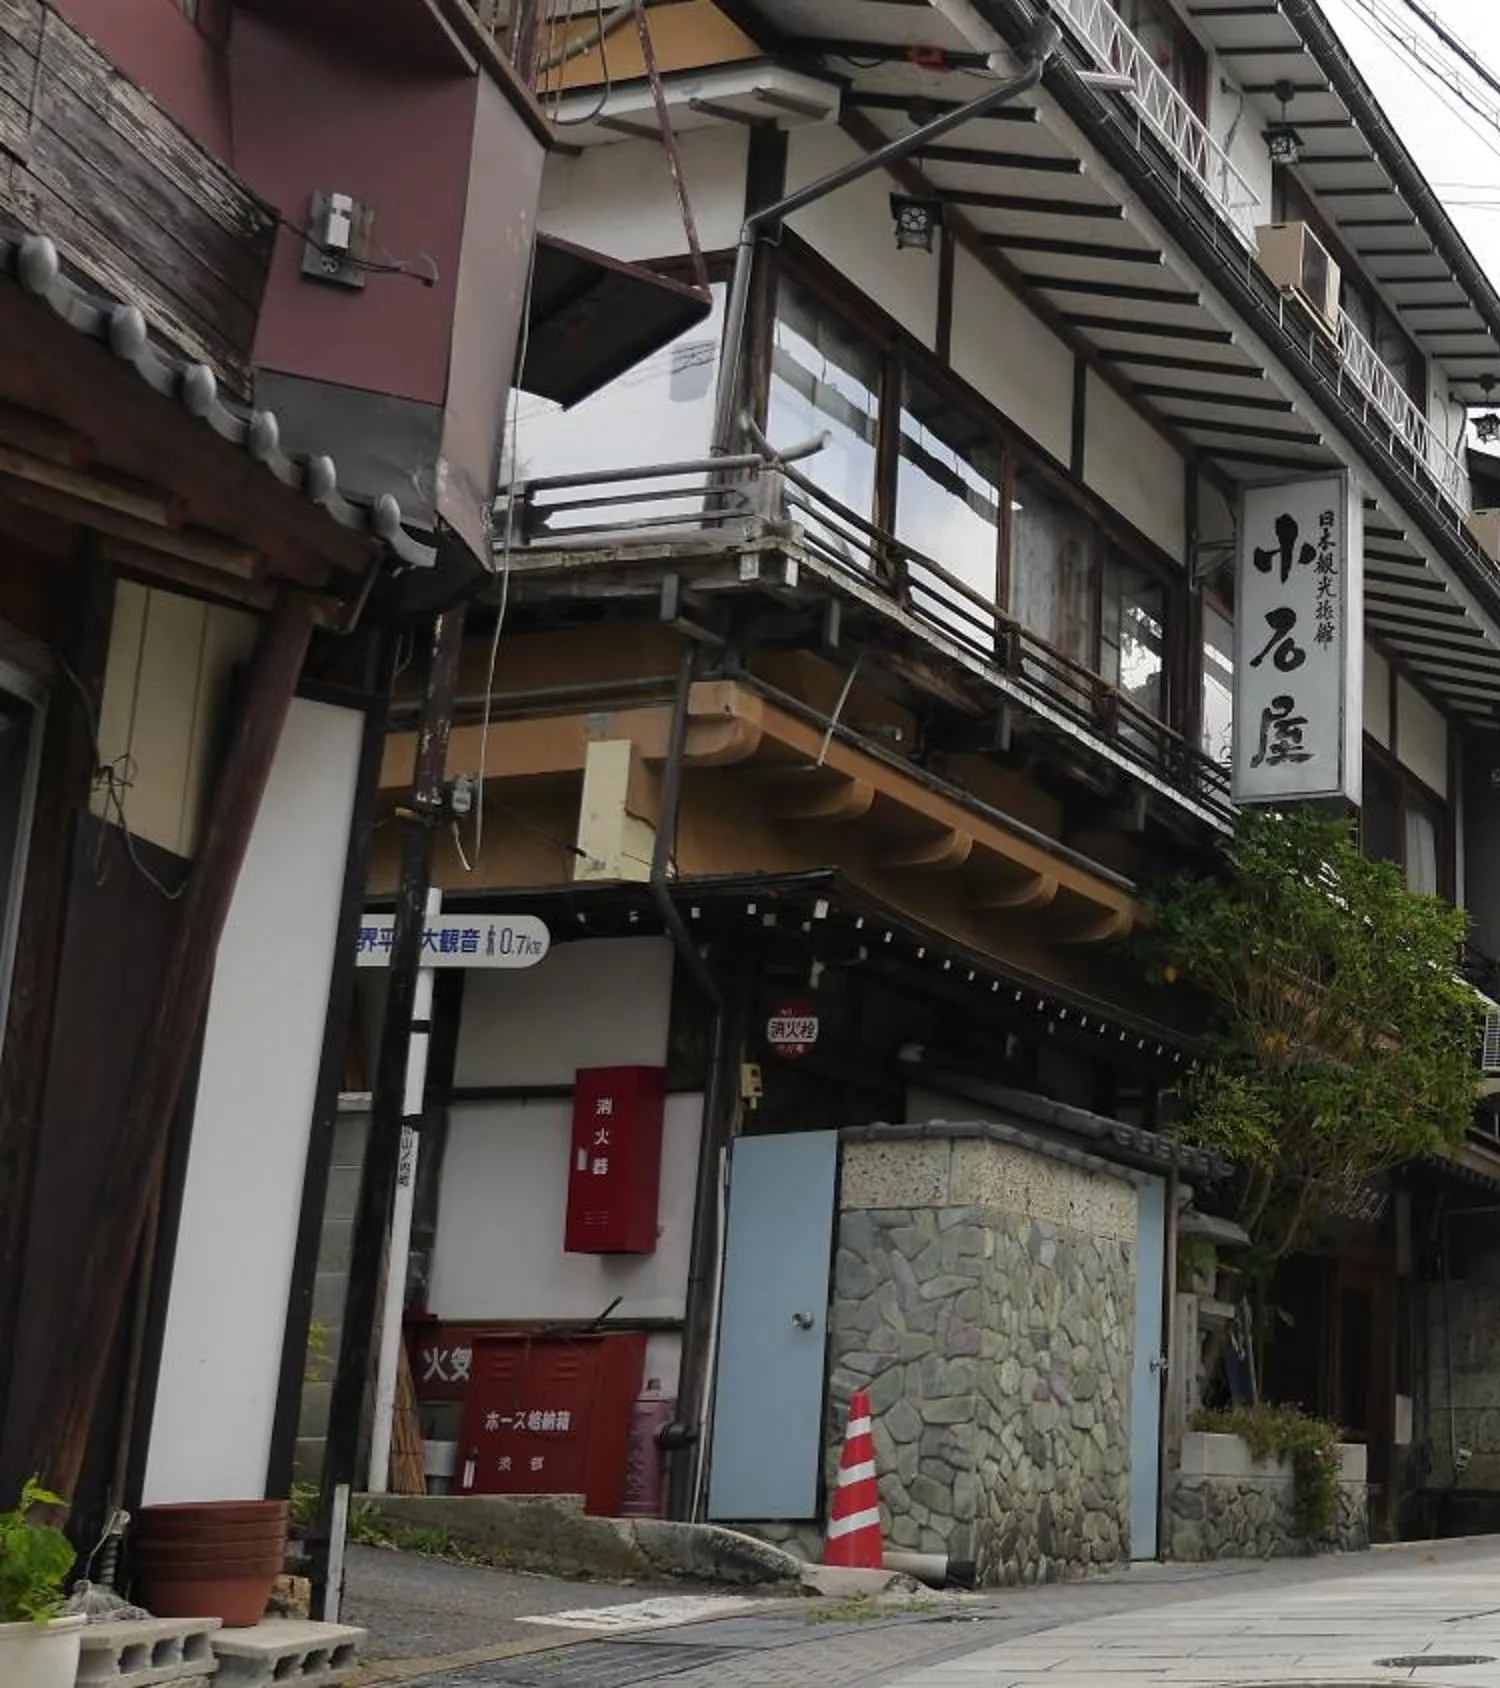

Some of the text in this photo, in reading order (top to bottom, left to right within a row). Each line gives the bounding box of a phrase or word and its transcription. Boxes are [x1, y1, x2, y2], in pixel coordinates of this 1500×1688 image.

[1313, 510, 1338, 649] 日本観光旅館
[1250, 513, 1317, 769] 小石屋
[356, 928, 480, 953] 界平大観音
[770, 1020, 815, 1038] 消火栓
[592, 1098, 612, 1174] 消火器
